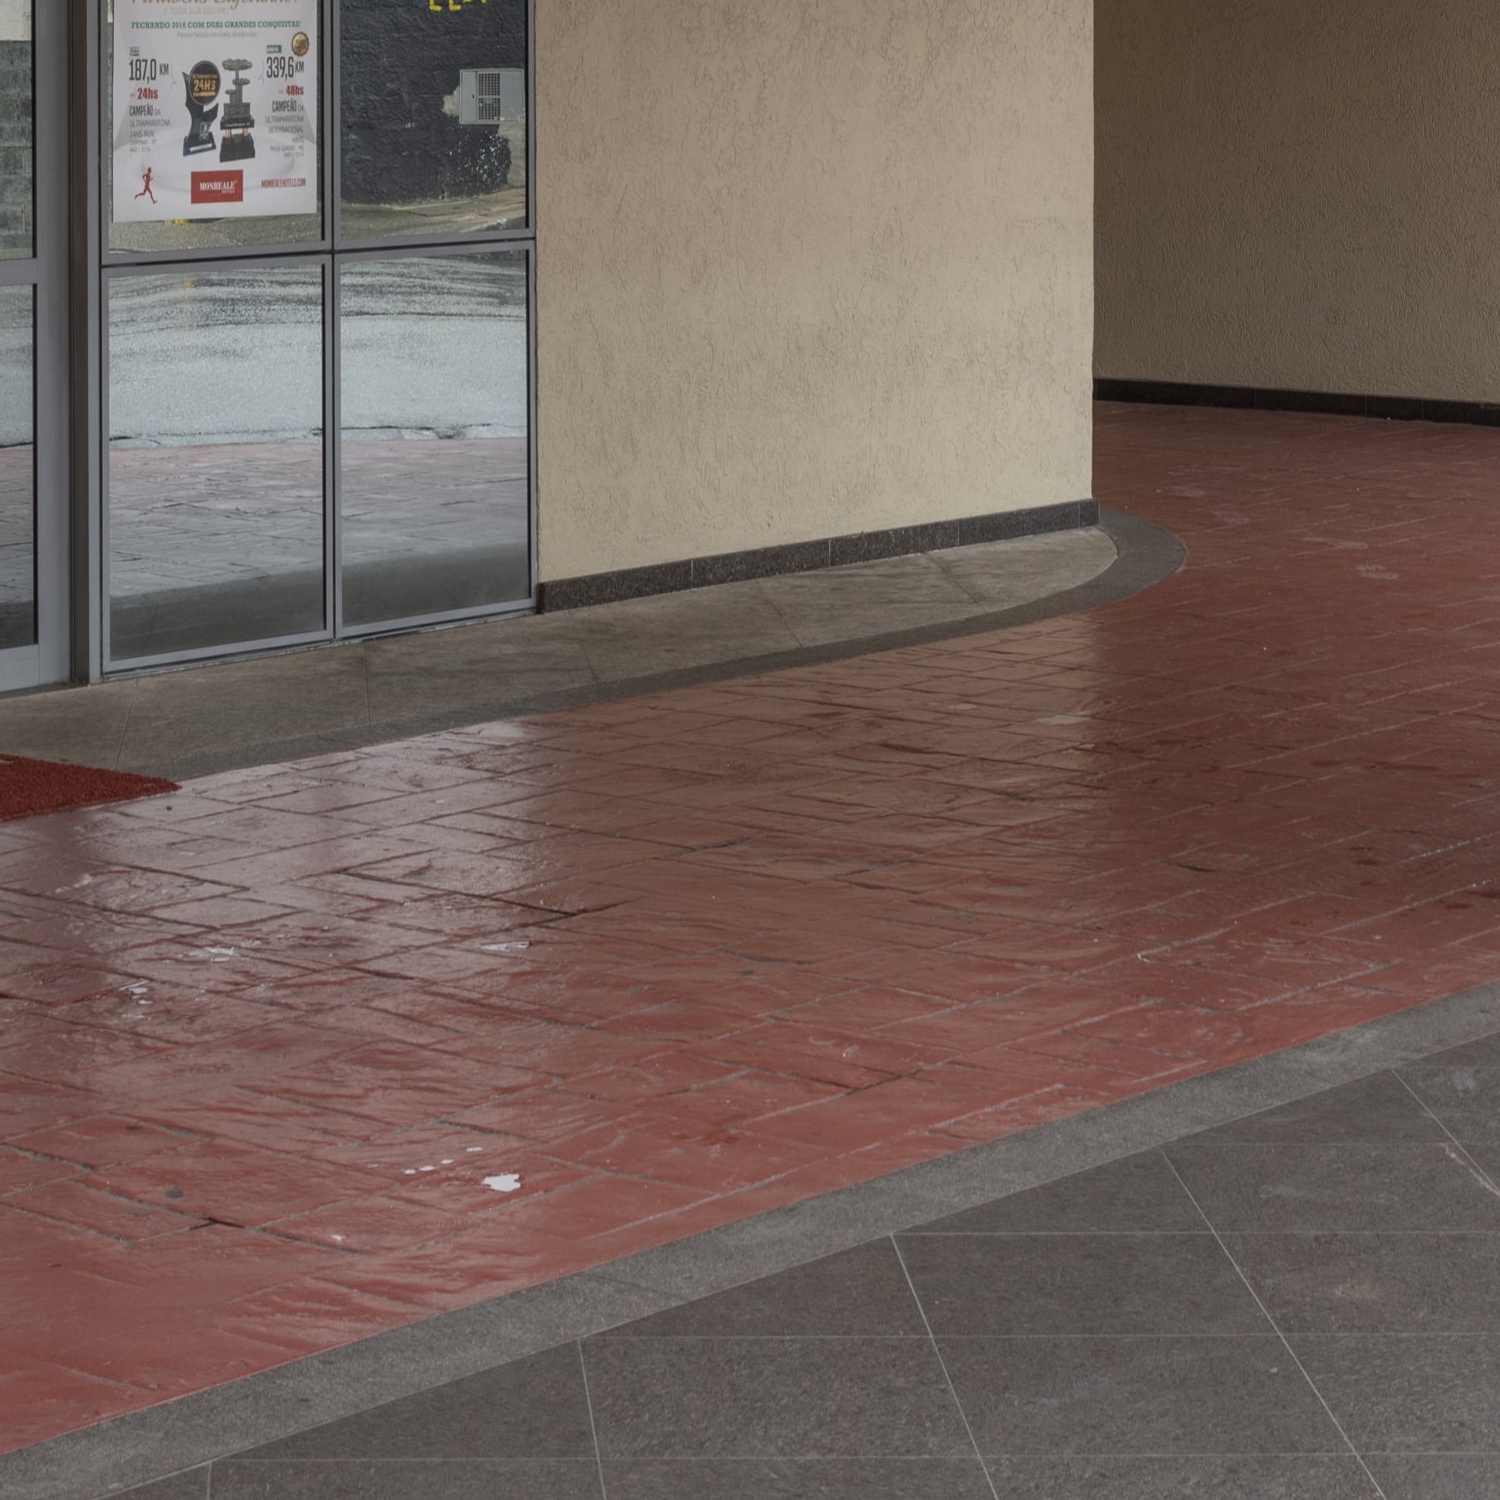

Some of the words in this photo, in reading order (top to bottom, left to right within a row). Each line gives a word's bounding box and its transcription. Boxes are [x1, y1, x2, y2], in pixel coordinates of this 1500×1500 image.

[131, 21, 171, 29] FECHANDO
[187, 21, 205, 29] COM
[205, 21, 224, 29] DUAS
[224, 21, 257, 29] GRANDES
[129, 59, 157, 84] 187,0
[159, 63, 169, 75] KM
[266, 56, 294, 81] 339,6
[295, 61, 305, 73] KM
[137, 87, 159, 100] 24hs
[285, 84, 304, 96] 48hs
[129, 102, 154, 117] CAMPEÃO
[271, 98, 297, 113] CAMPEÃO
[199, 181, 235, 191] MONREALE
